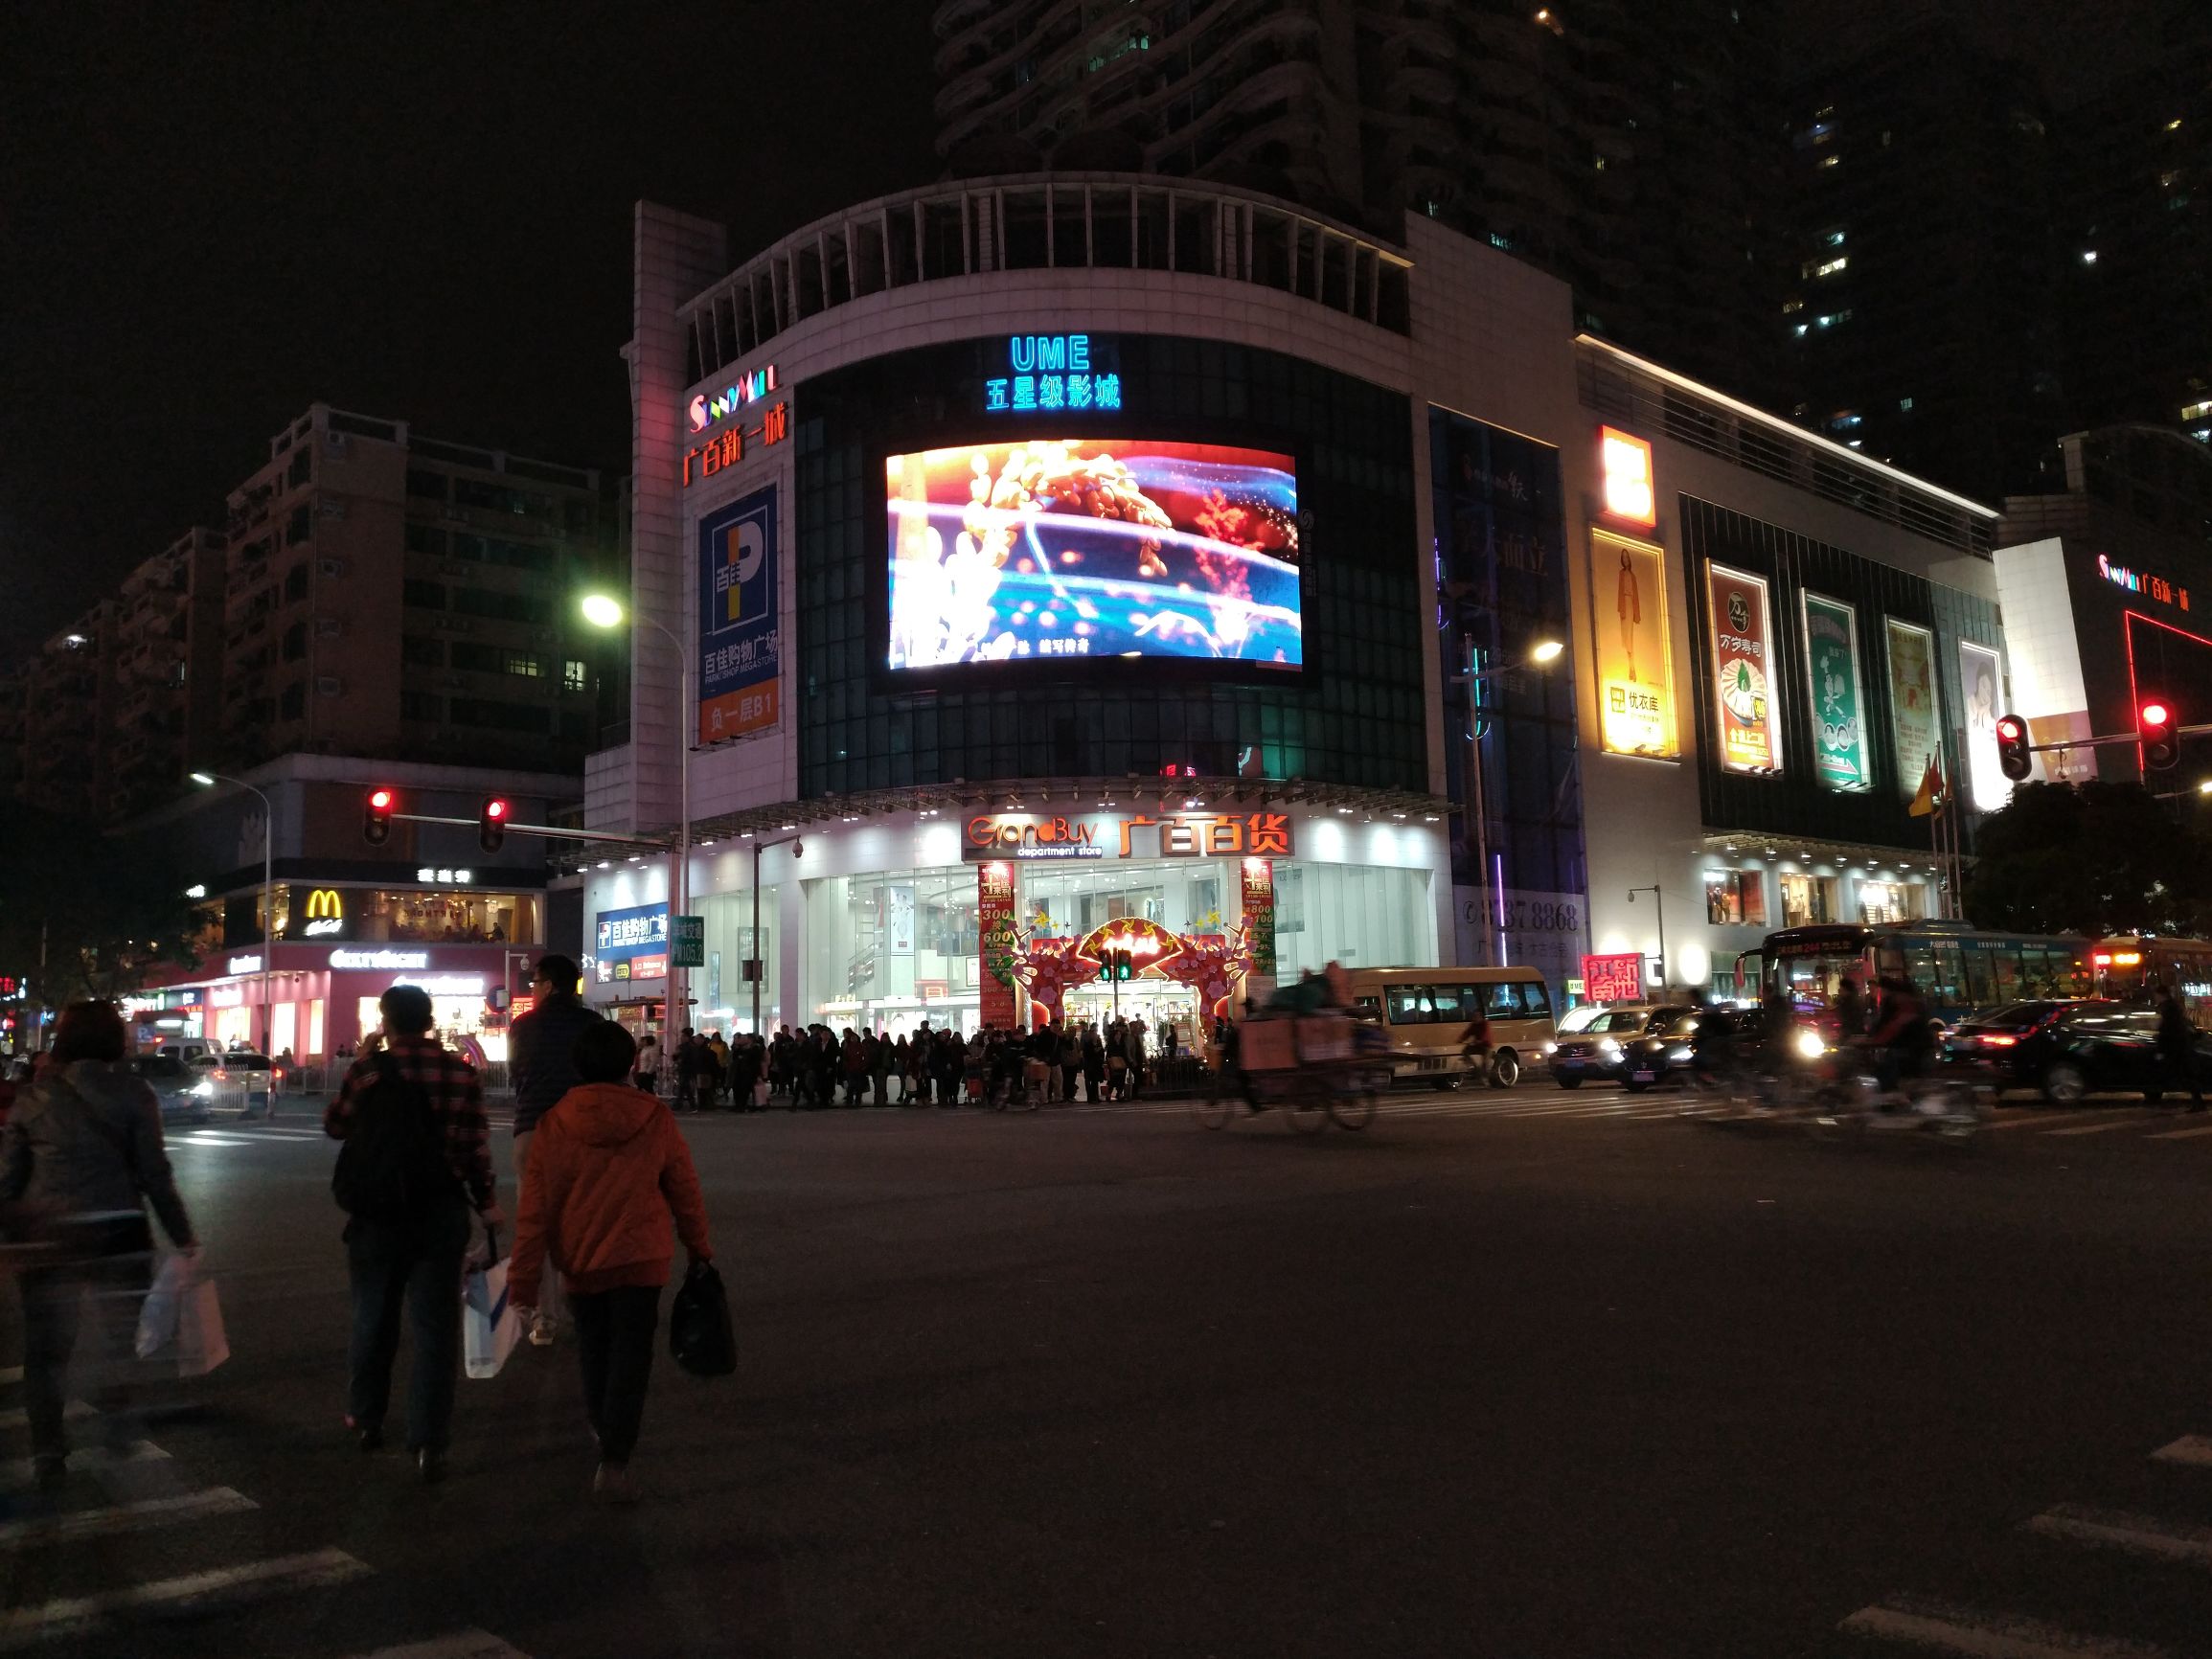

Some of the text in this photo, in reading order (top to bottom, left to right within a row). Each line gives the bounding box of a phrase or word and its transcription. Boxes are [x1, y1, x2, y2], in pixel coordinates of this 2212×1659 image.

[1012, 335, 1089, 371] UME
[987, 374, 1120, 410] 五星级影城
[683, 401, 786, 488] 广百新一城
[705, 629, 778, 675] 百佳购物广场
[1720, 633, 1762, 658] 万岁寿司
[712, 693, 771, 733] 负一层B1
[1630, 692, 1659, 713] 优衣库
[1118, 813, 1289, 857] 广百百货
[1017, 846, 1102, 859] department store
[982, 909, 1011, 920] 300
[1251, 905, 1271, 914] 800
[1532, 900, 1579, 931] 8868
[612, 914, 668, 940] 百佳购物广场
[983, 931, 1012, 943] 600
